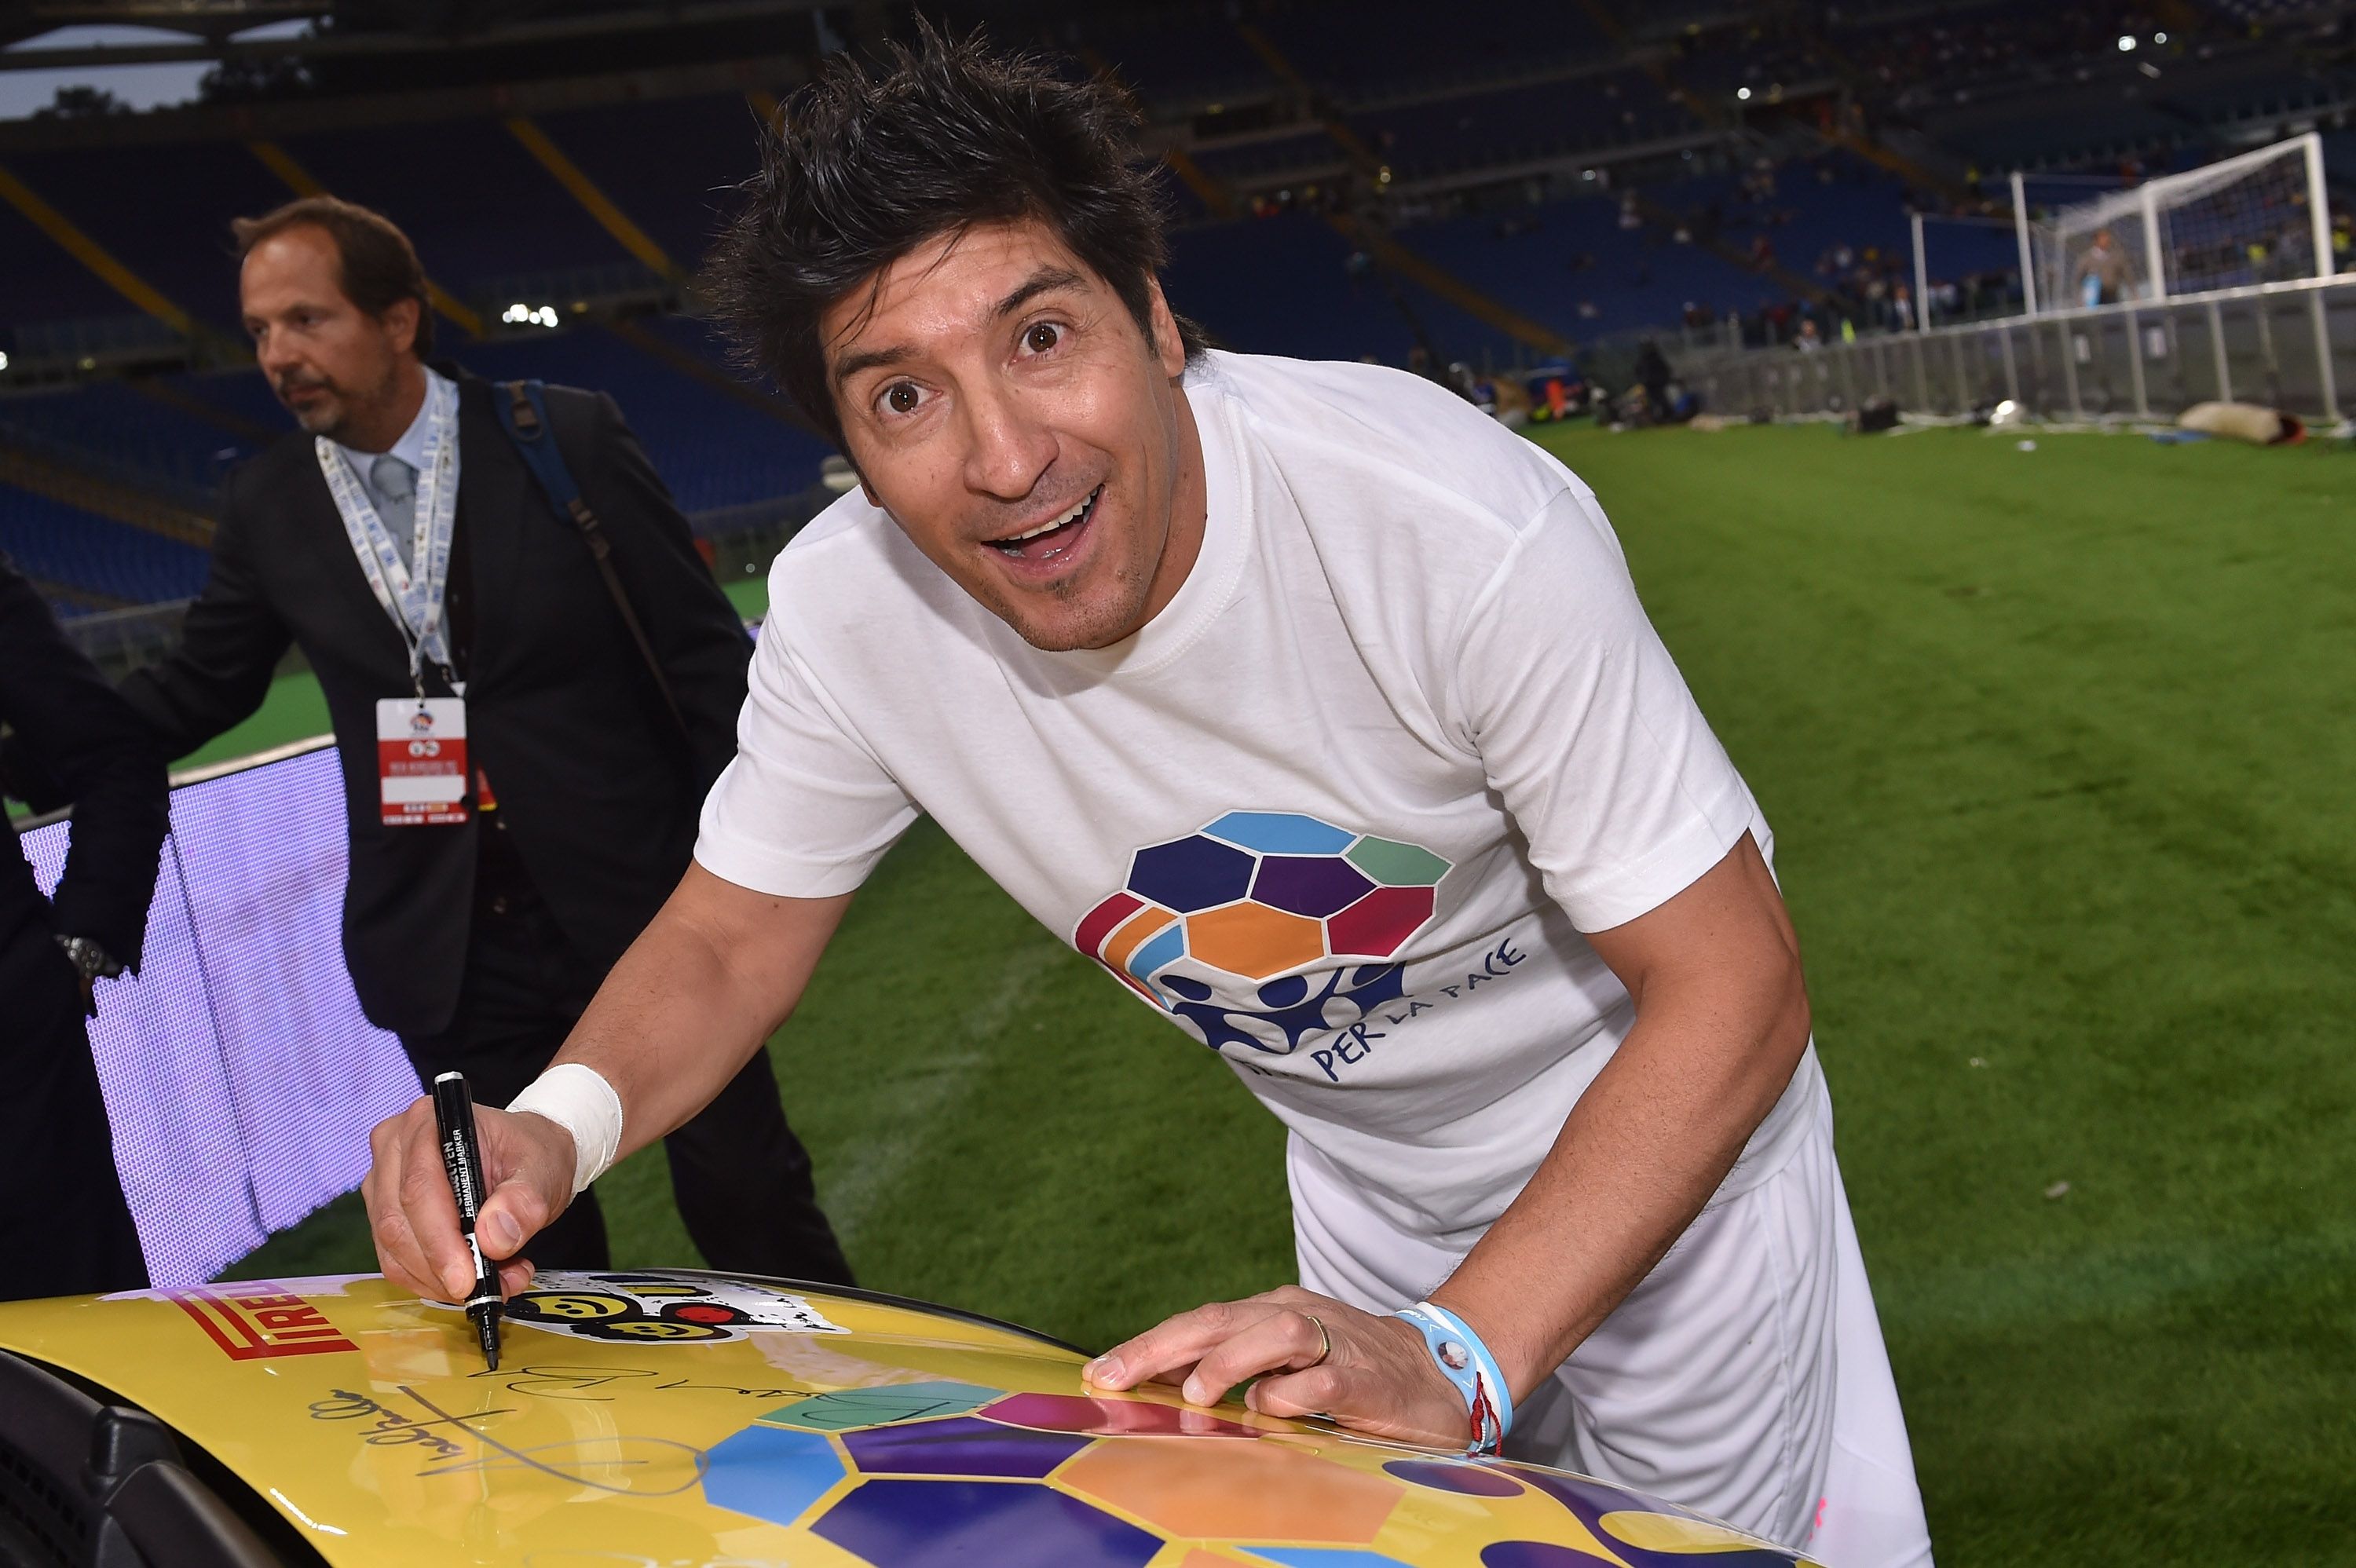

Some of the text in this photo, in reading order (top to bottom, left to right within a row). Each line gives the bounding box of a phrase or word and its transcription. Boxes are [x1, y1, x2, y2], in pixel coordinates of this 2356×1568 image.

[1311, 938, 1526, 1082] PER LA PACE
[452, 1129, 466, 1165] MARKER
[459, 1166, 474, 1218] PERMANENT
